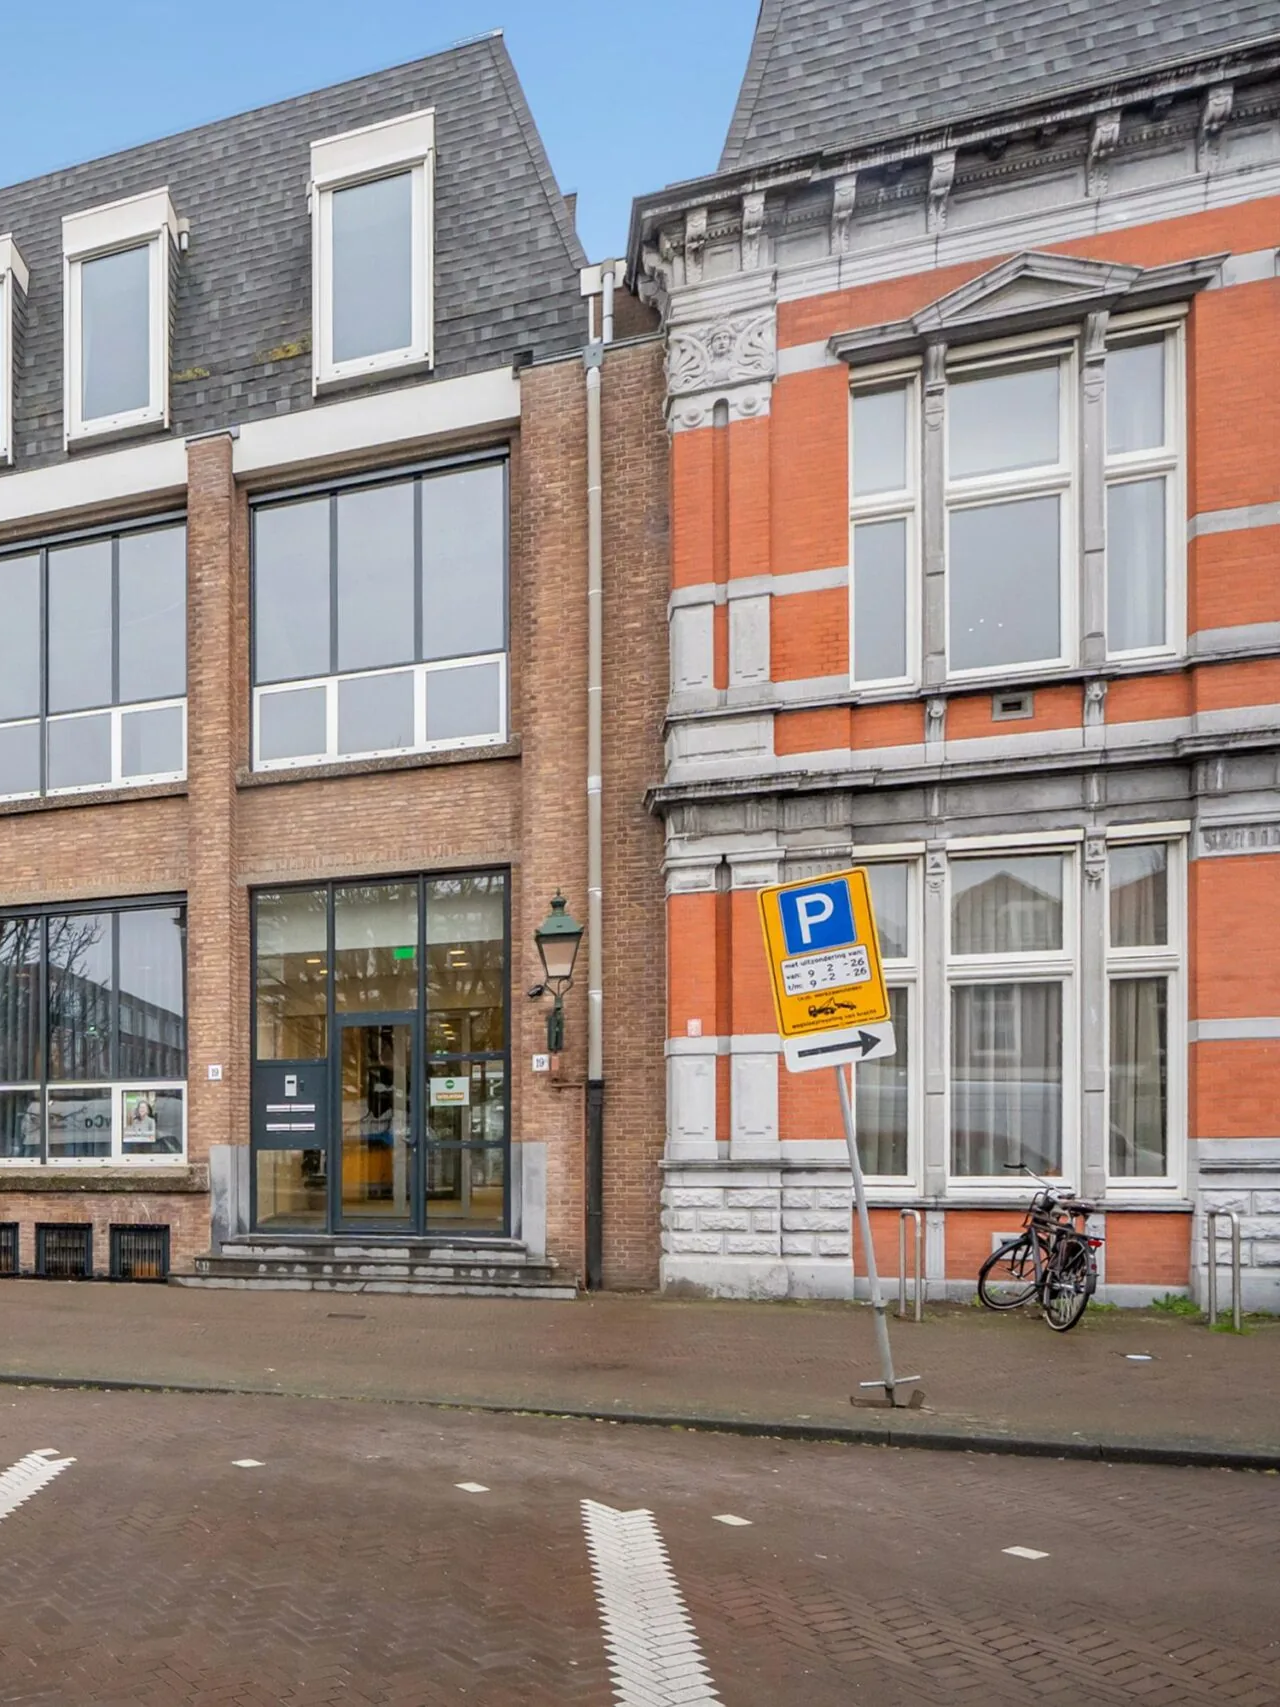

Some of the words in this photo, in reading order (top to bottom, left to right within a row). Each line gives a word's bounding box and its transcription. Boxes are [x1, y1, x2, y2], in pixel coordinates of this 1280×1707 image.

[796, 893, 834, 945] P
[800, 953, 846, 967] uitzondering
[807, 969, 815, 978] 9
[826, 963, 834, 972] 2
[809, 979, 817, 988] 9
[829, 972, 836, 981] 2
[535, 1057, 545, 1069] 19
